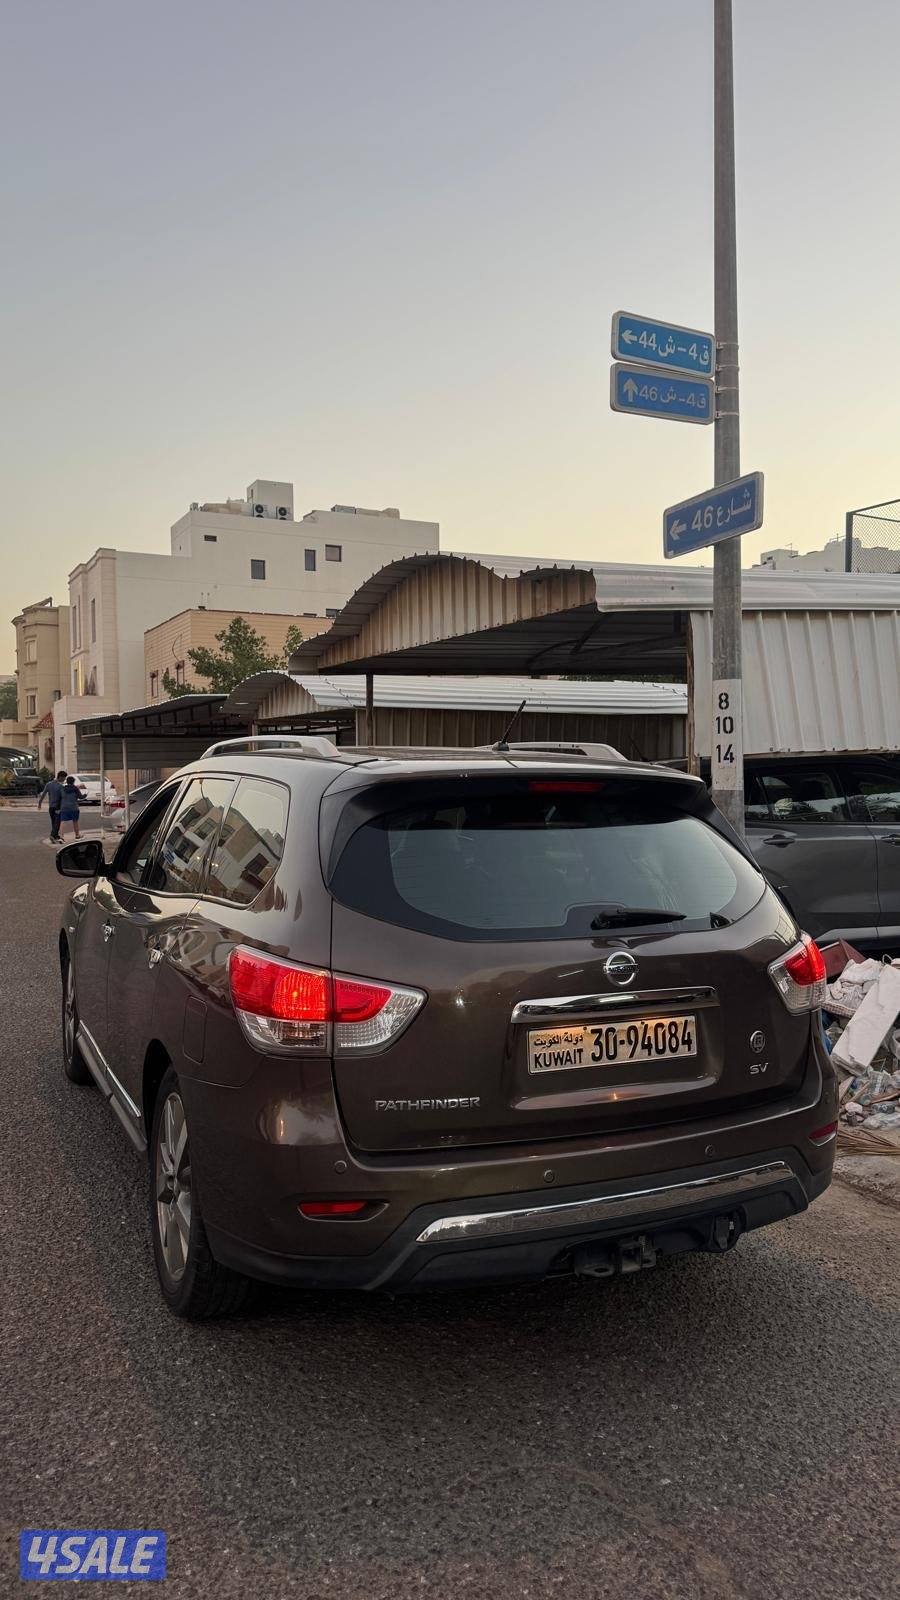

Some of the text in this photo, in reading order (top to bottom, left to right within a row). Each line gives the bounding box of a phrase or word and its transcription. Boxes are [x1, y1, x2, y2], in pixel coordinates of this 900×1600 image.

[691, 488, 752, 531] شارع 46
[718, 692, 730, 710] 8
[715, 716, 734, 734] 10
[716, 744, 735, 763] 14
[533, 1031, 584, 1048] دولة الكويت
[590, 1019, 693, 1062] 30-94084
[534, 1049, 584, 1068] KUWAIT
[750, 1062, 769, 1075] SV
[374, 1096, 481, 1111] PATHFINDER
